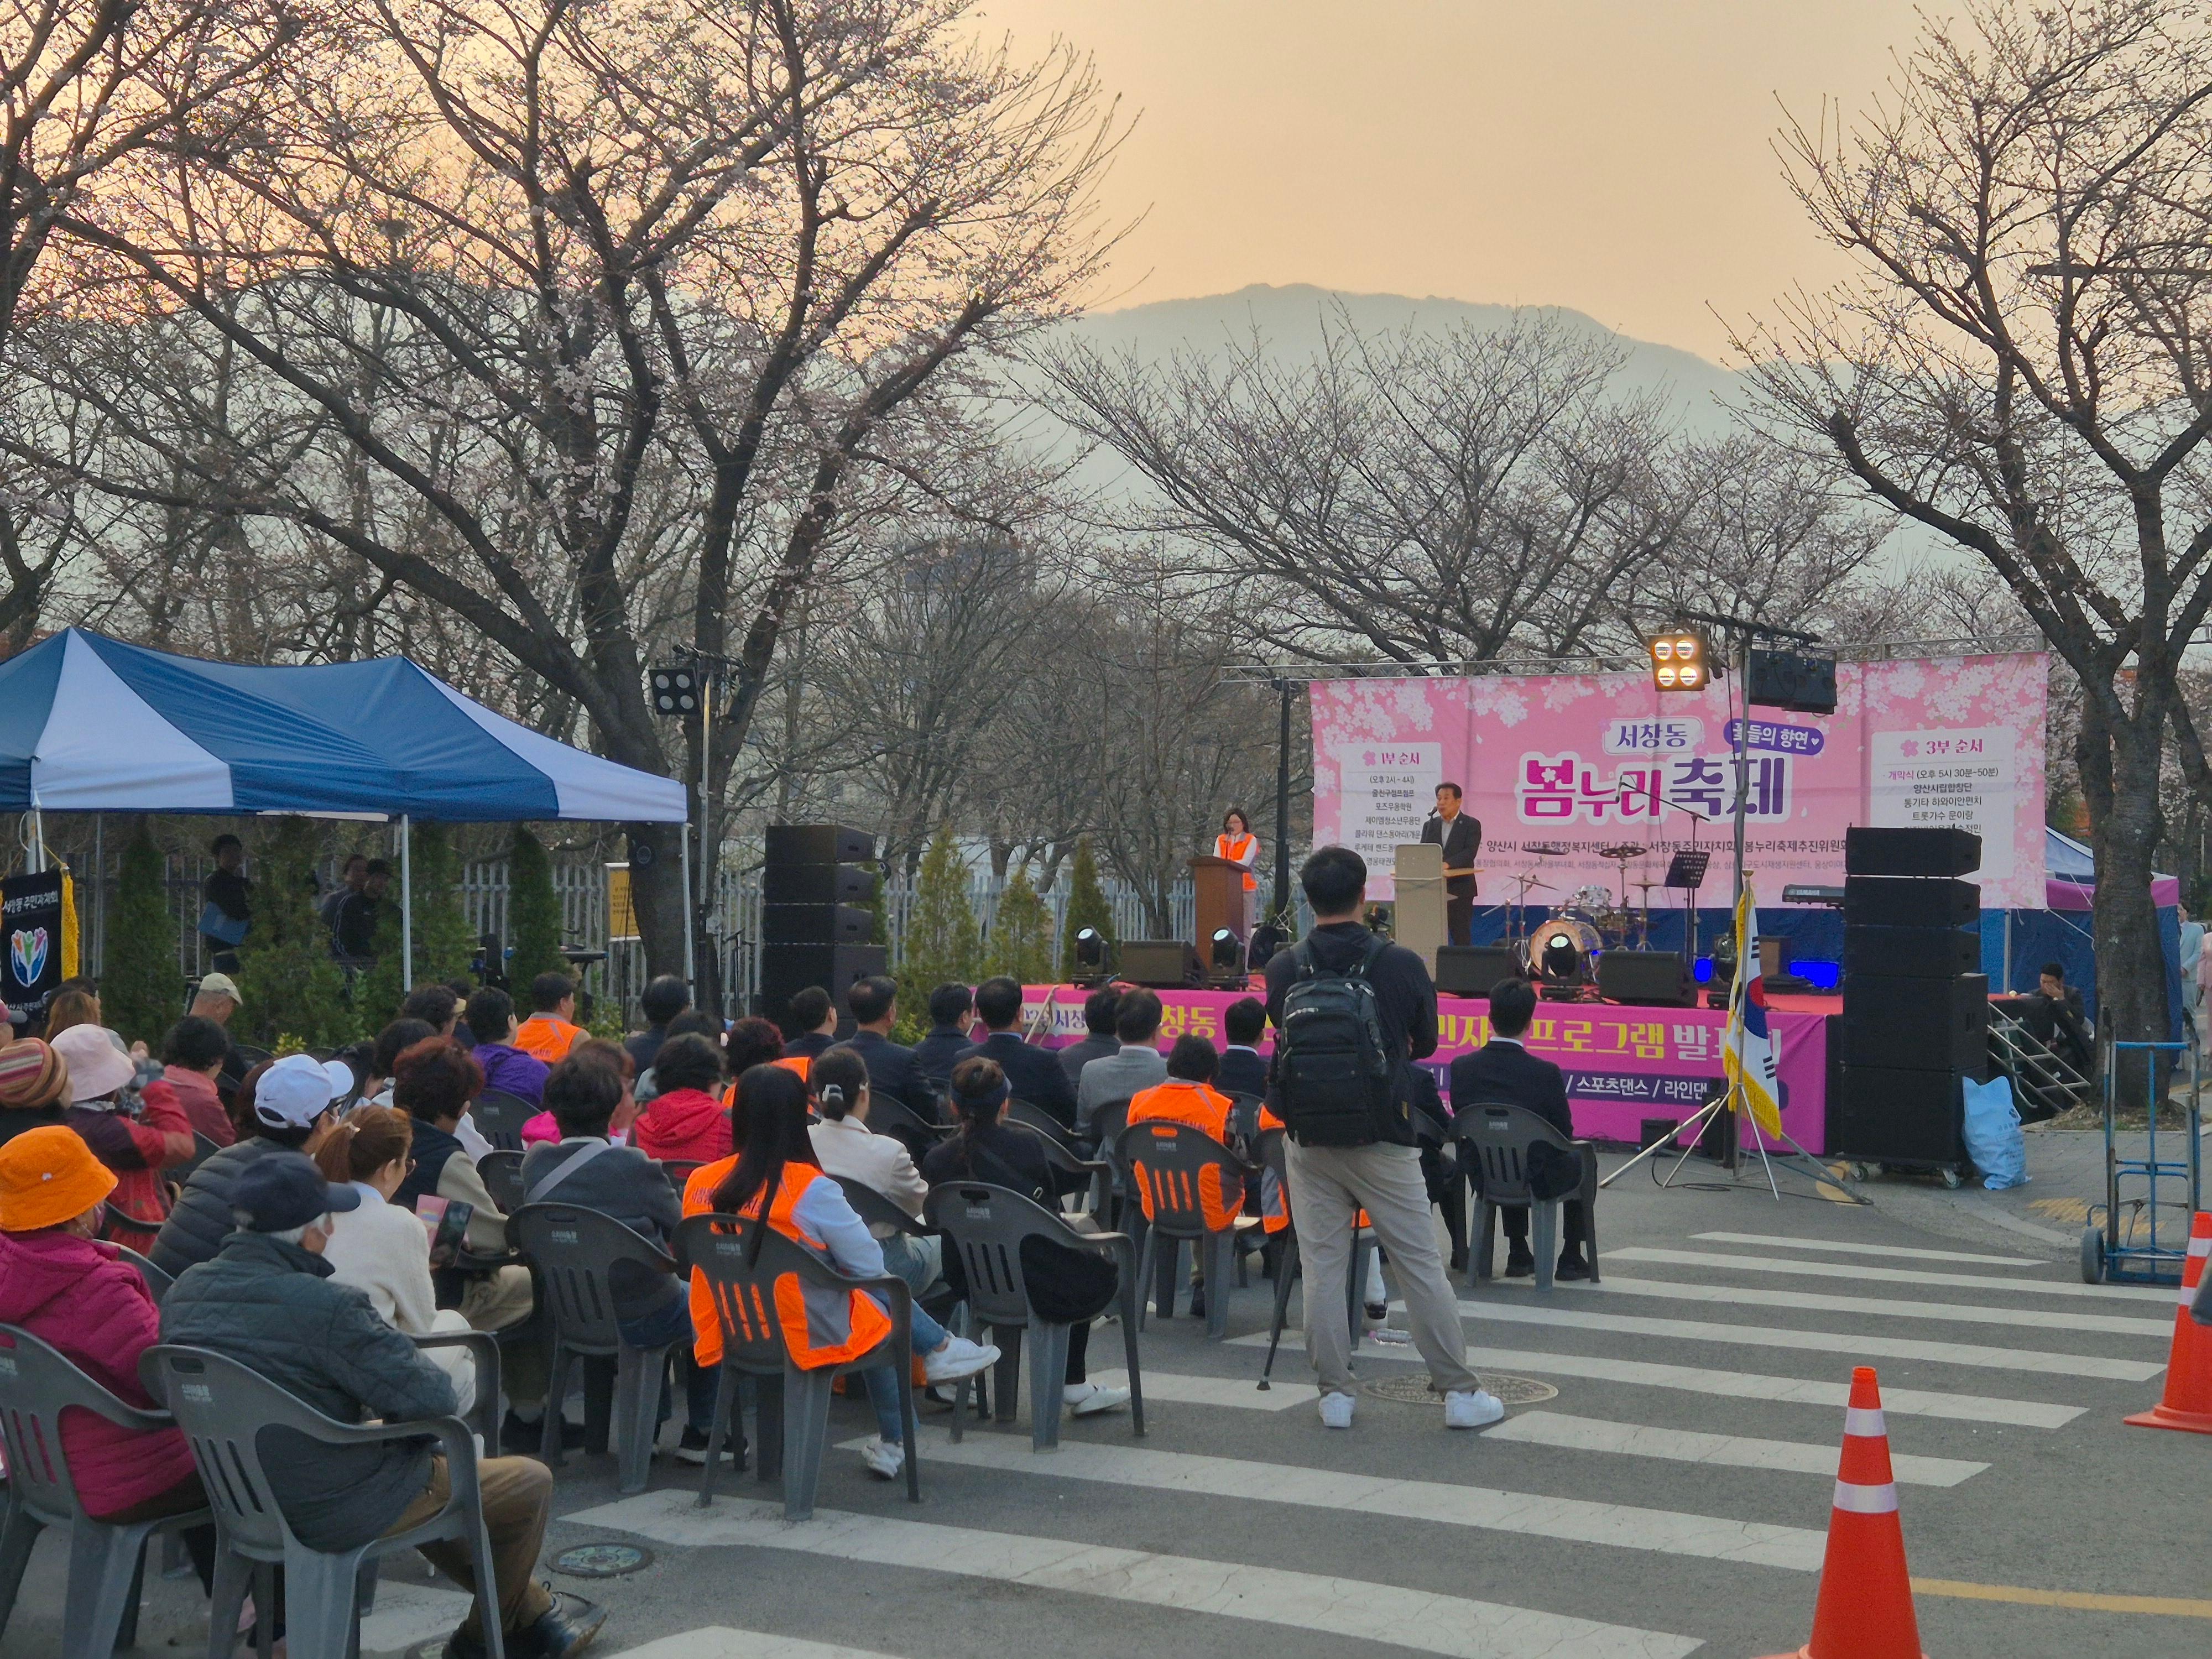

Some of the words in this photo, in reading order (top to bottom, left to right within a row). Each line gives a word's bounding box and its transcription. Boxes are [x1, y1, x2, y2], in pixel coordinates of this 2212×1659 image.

[1616, 723, 1688, 748] 서창동
[1780, 729, 1809, 750] 향연
[1926, 740, 1950, 754] 3부
[1955, 739, 1983, 753] 순서
[1399, 752, 1420, 765] 순서
[1888, 770, 1914, 780] 개막식
[1938, 769, 1952, 778] 5시
[1913, 782, 1973, 794] 양산시립합창단
[1904, 798, 1929, 808] 통기타
[1932, 796, 1981, 806] 하와이안펀치
[1912, 811, 1945, 821] 트롯가수
[1949, 811, 1973, 820] 문이랑
[1486, 840, 1517, 853] 양산시
[1161, 1004, 1217, 1039] 창동
[1525, 1018, 1665, 1060] 프로그램
[1576, 1076, 1649, 1097] 스포츠댄스
[1664, 1080, 1708, 1100] 라인댄
